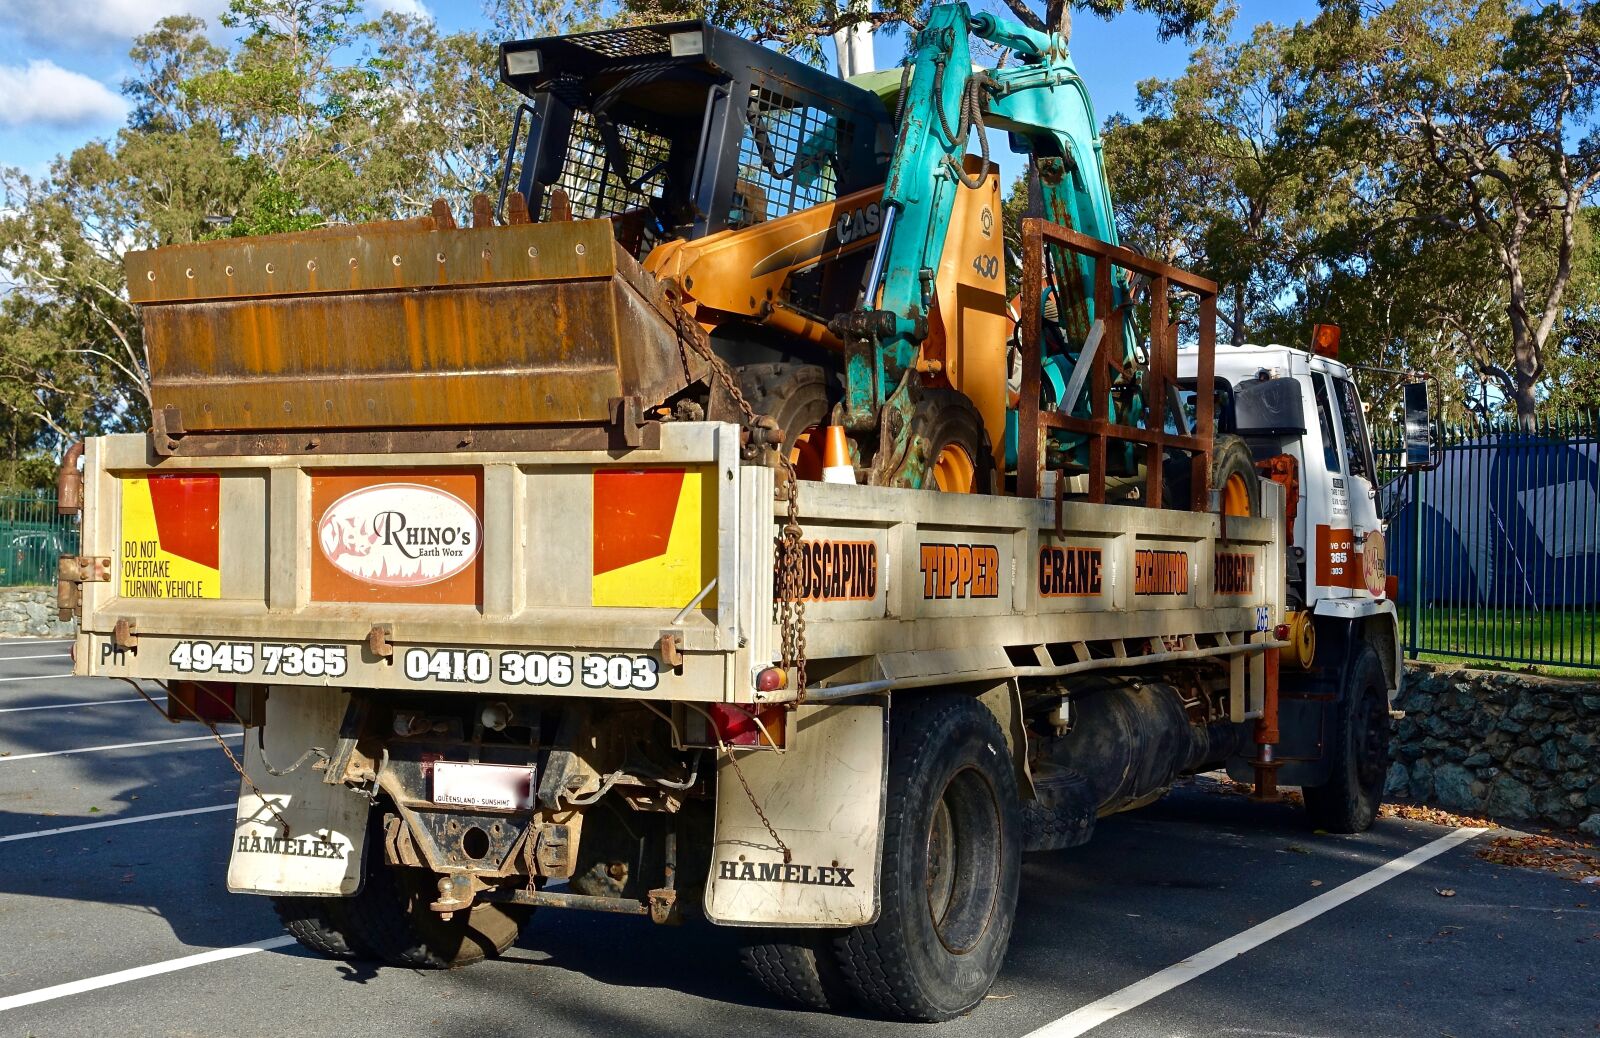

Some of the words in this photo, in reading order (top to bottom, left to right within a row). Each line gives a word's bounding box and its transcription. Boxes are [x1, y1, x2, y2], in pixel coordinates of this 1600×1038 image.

[836, 203, 886, 243] CAS
[125, 541, 137, 558] DO
[140, 541, 157, 558] NOT
[419, 547, 440, 557] Earth
[442, 547, 463, 557] Worx
[125, 561, 170, 578] OVERTAKE
[919, 542, 999, 600] TIPPER
[1038, 545, 1102, 597] CRANE
[1135, 549, 1189, 596] EXCAVATOR
[125, 580, 162, 598] TURNING
[165, 581, 203, 598] VEHICLE
[1256, 607, 1269, 631] 265
[100, 643, 126, 667] Ph
[170, 641, 254, 673] 4945
[261, 643, 348, 677] 7365
[404, 648, 492, 684] 0410
[499, 651, 573, 687] 306
[581, 653, 659, 691] 303
[437, 795, 476, 804] QUEENSLAND
[237, 836, 345, 860] HAMELEX
[719, 861, 855, 887] HAMELEX
